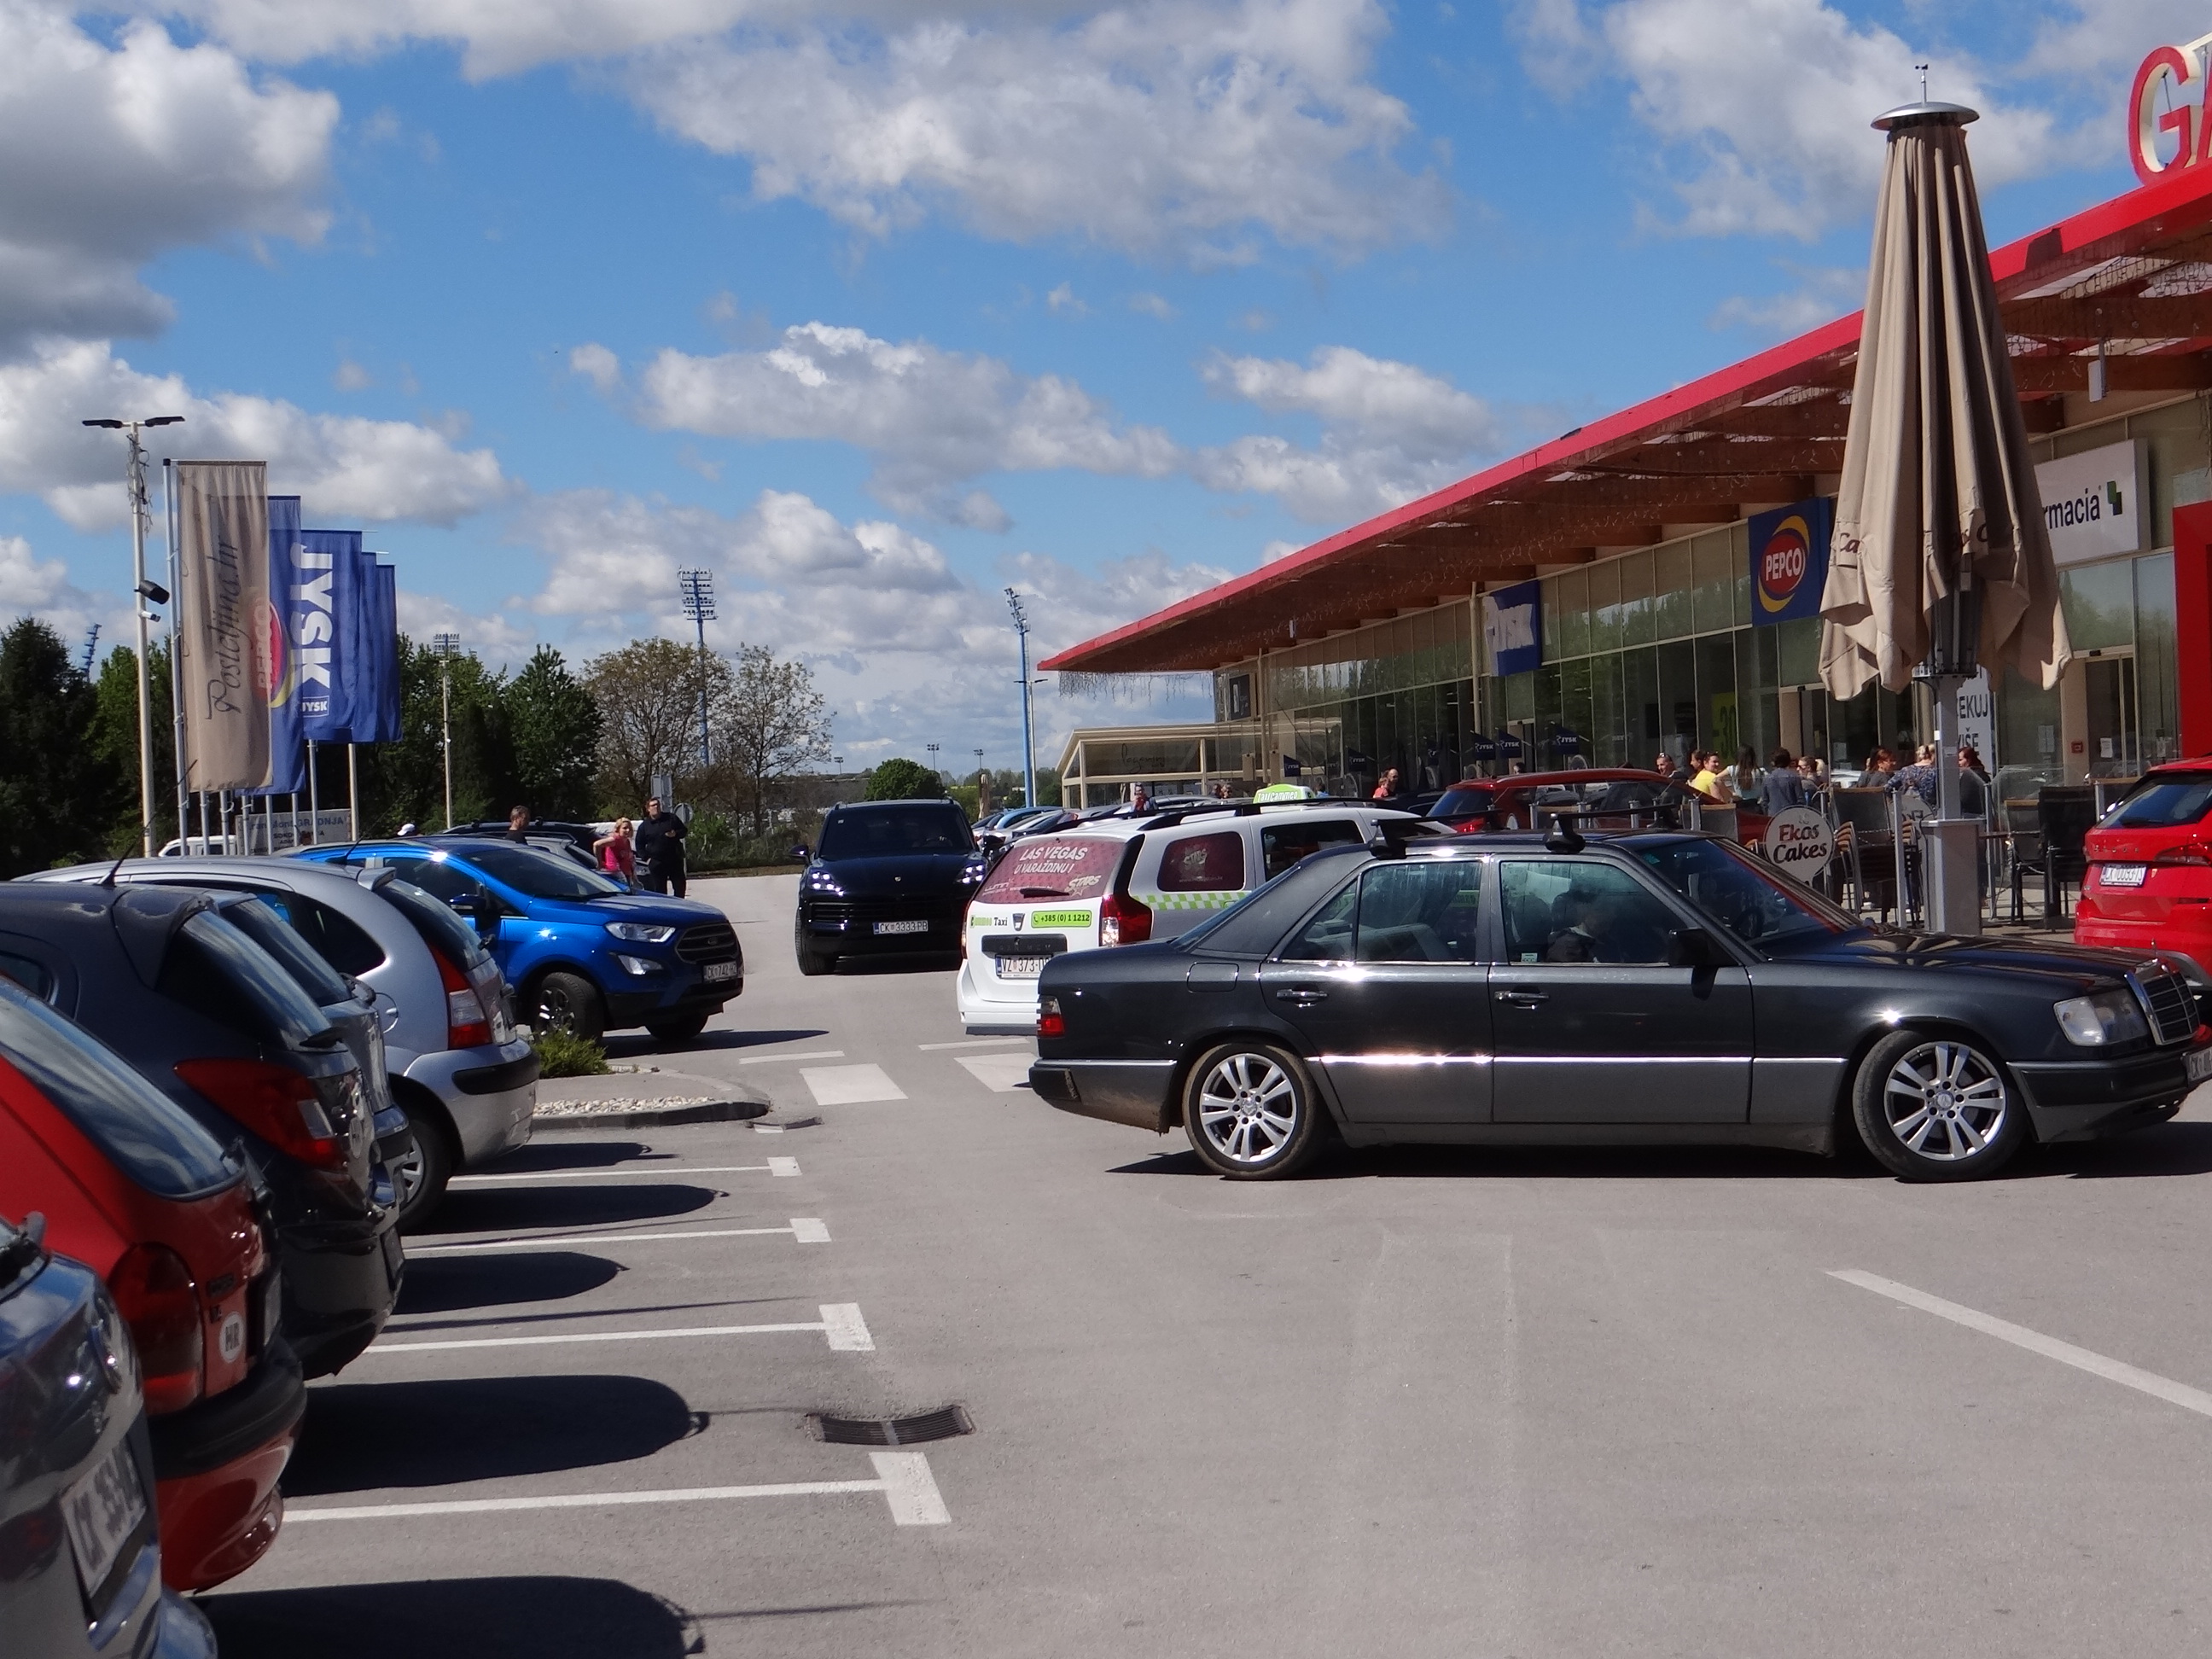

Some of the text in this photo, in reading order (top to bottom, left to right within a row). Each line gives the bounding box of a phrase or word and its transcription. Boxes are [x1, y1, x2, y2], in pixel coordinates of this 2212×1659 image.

[1765, 547, 1802, 581] PEPCO
[290, 542, 333, 690] JYSK
[301, 700, 328, 713] JYSK
[1958, 693, 1988, 719] EKUJ
[1019, 846, 1088, 861] LAS VEGAS
[1773, 842, 1827, 864] Cakes
[1065, 875, 1102, 892] STARS
[993, 917, 1008, 926] Taxi
